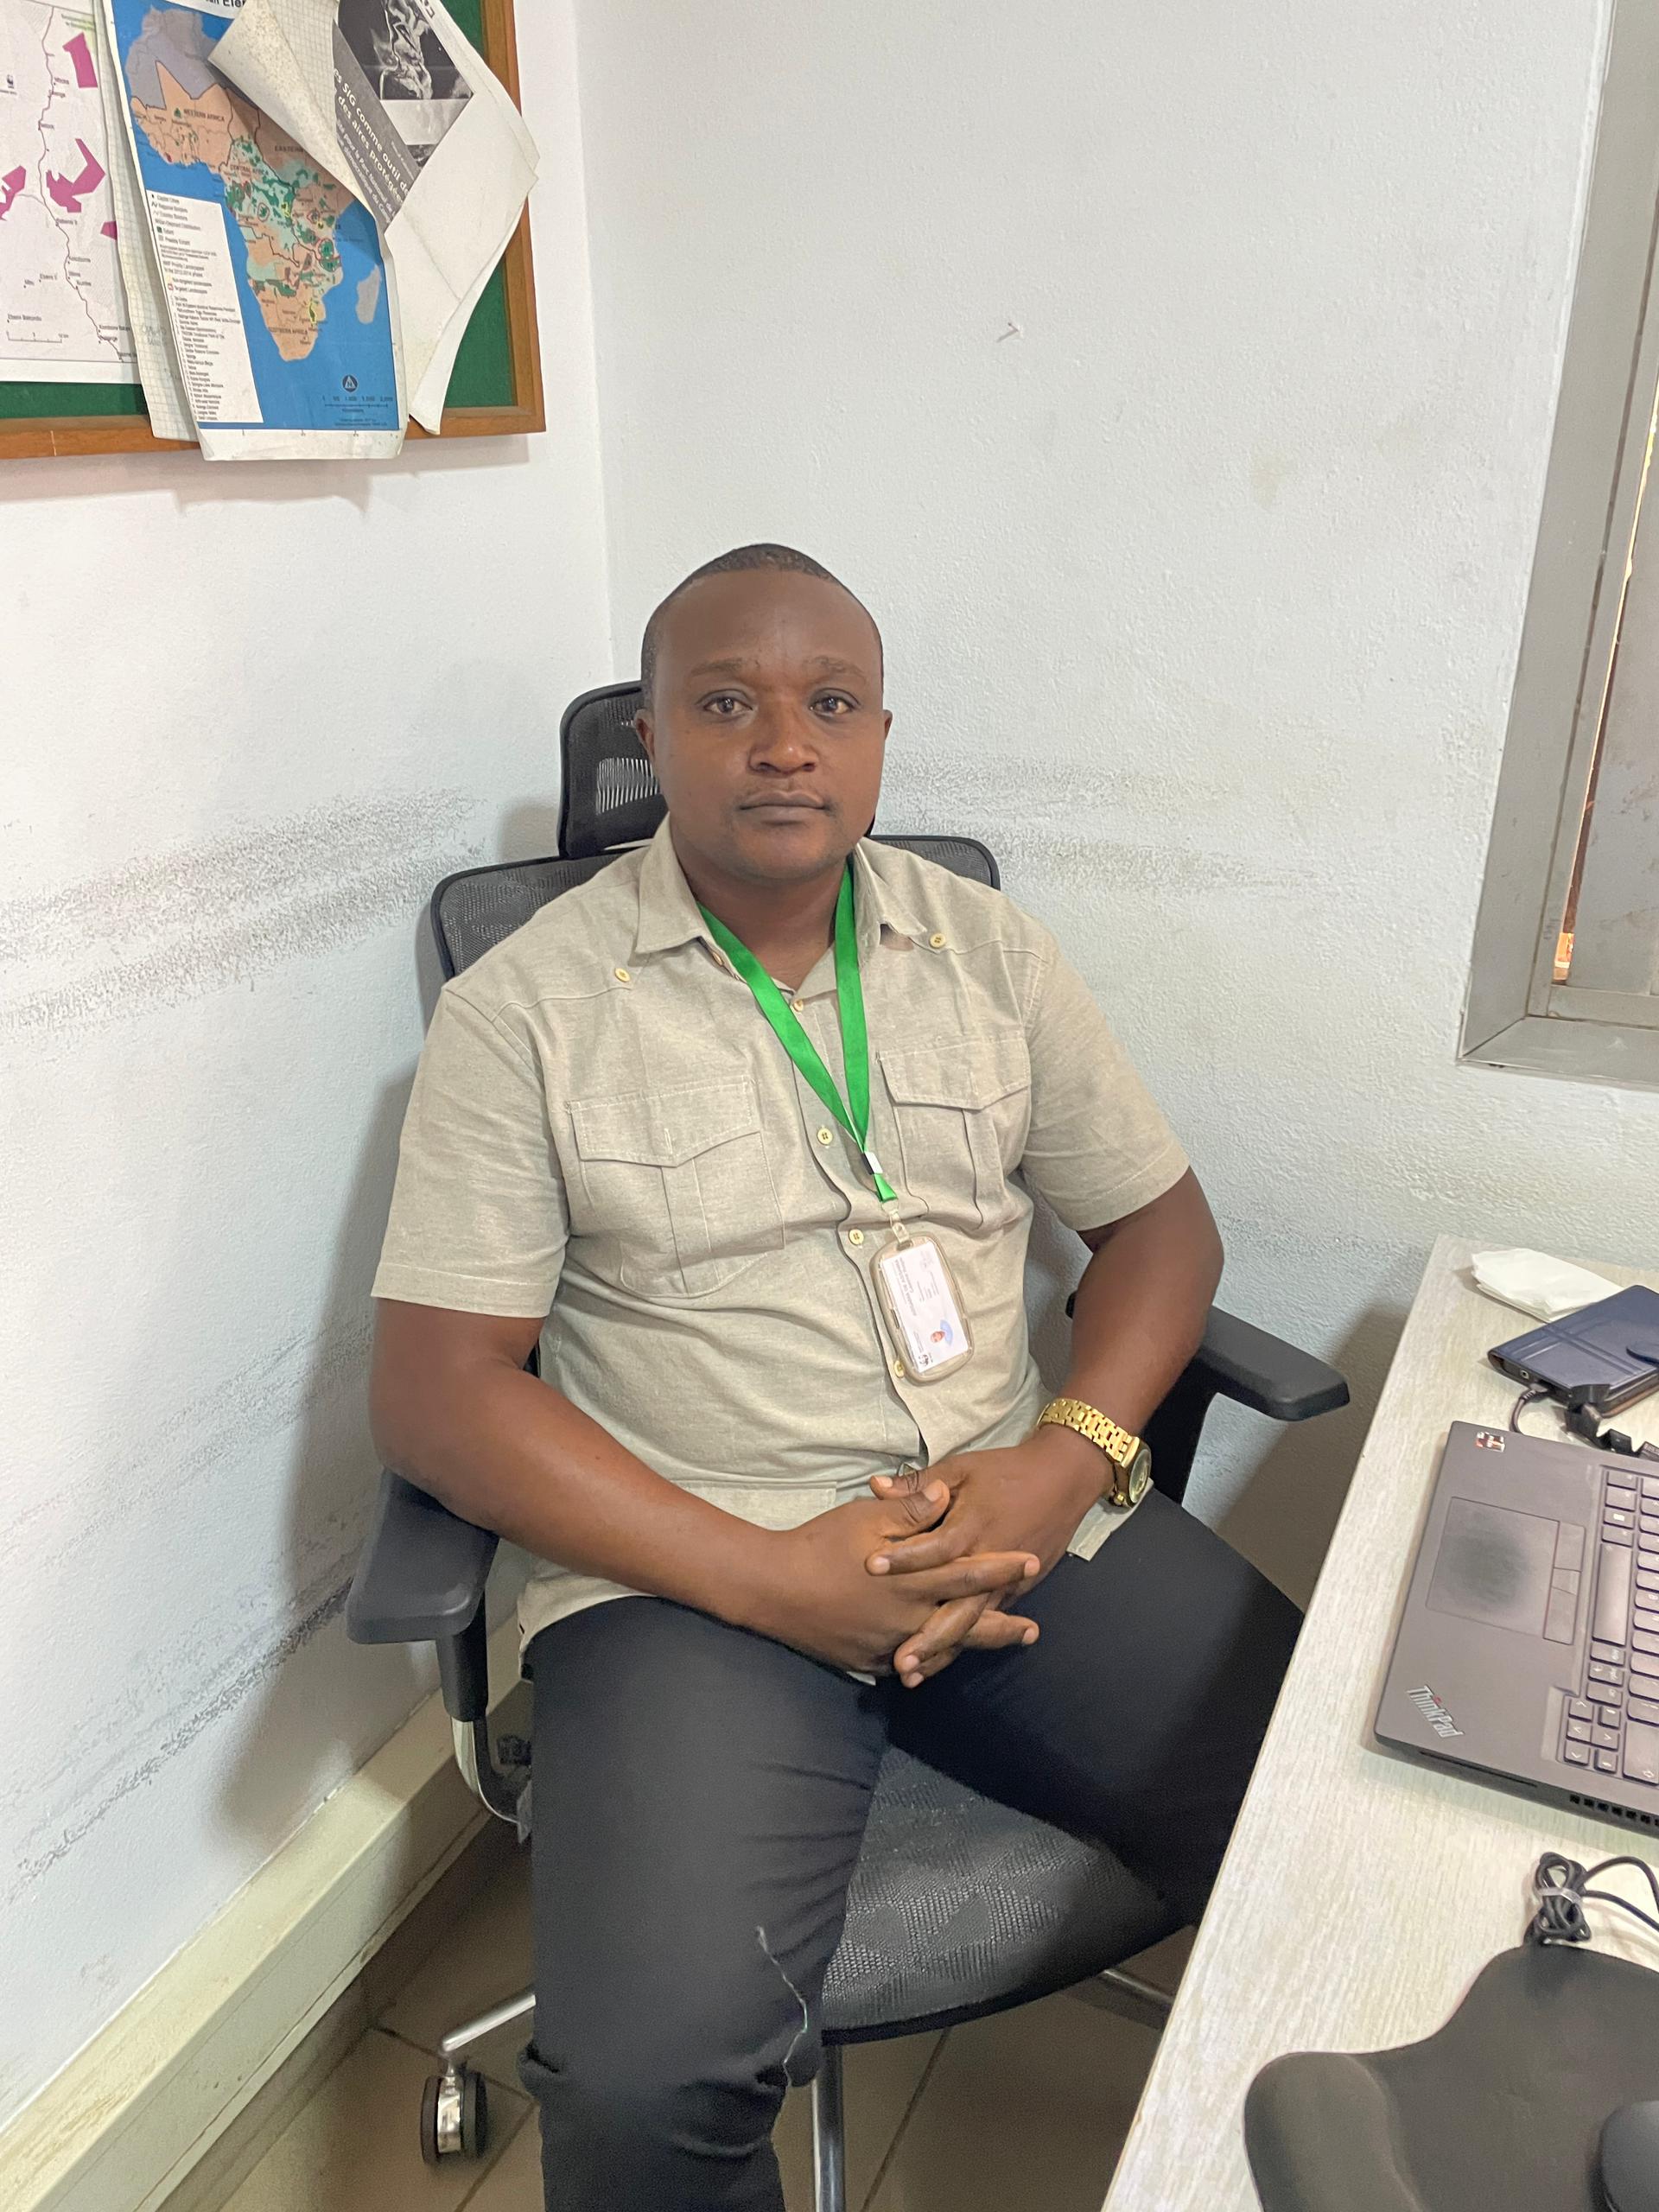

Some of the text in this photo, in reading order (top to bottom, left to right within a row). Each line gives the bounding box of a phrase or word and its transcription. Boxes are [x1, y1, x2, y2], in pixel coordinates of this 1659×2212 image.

[338, 96, 352, 120] des
[352, 119, 370, 149] aires
[342, 82, 356, 106] SIG
[356, 107, 383, 152] comme
[383, 153, 401, 184] outil
[1407, 1686, 1465, 1738] ThinkPad
